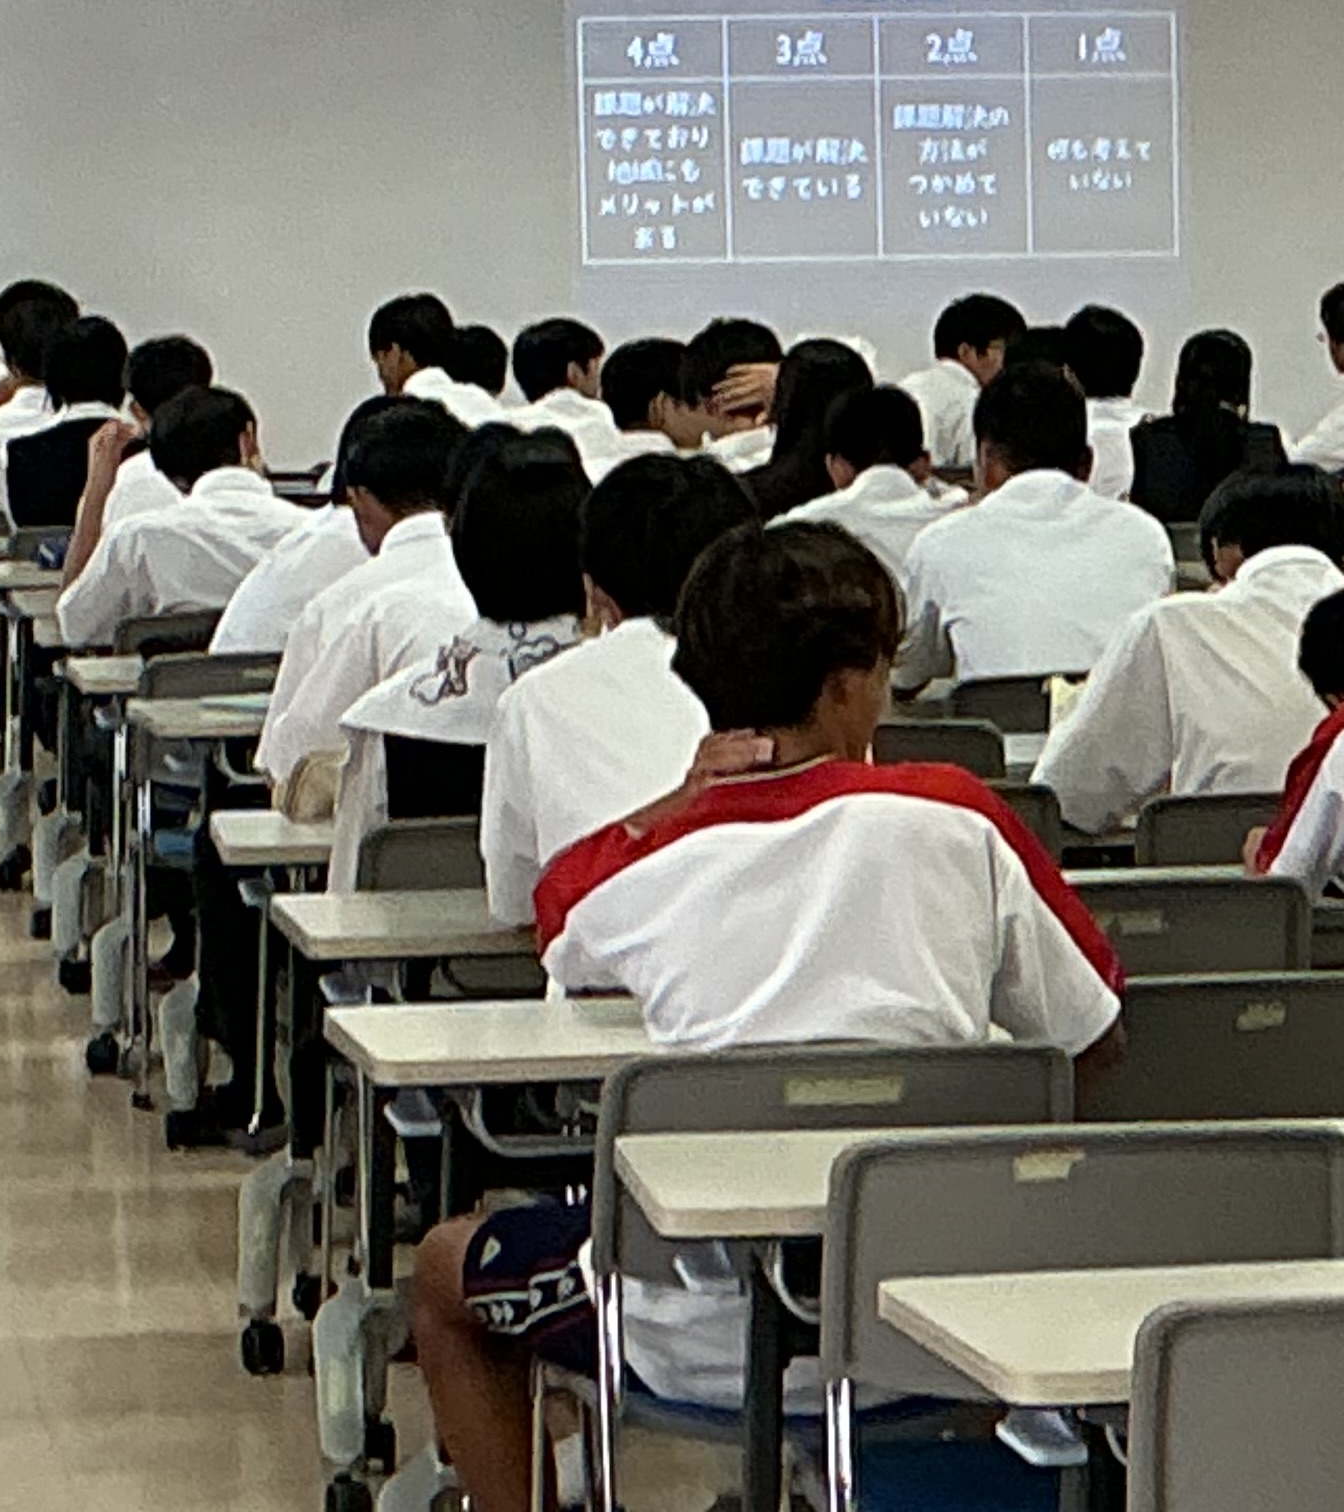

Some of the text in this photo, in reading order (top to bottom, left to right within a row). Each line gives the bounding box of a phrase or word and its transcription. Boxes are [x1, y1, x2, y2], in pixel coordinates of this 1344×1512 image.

[626, 32, 680, 69] 4点
[775, 30, 828, 67] 3点
[925, 27, 978, 66] 2点
[1078, 27, 1126, 63] 1点
